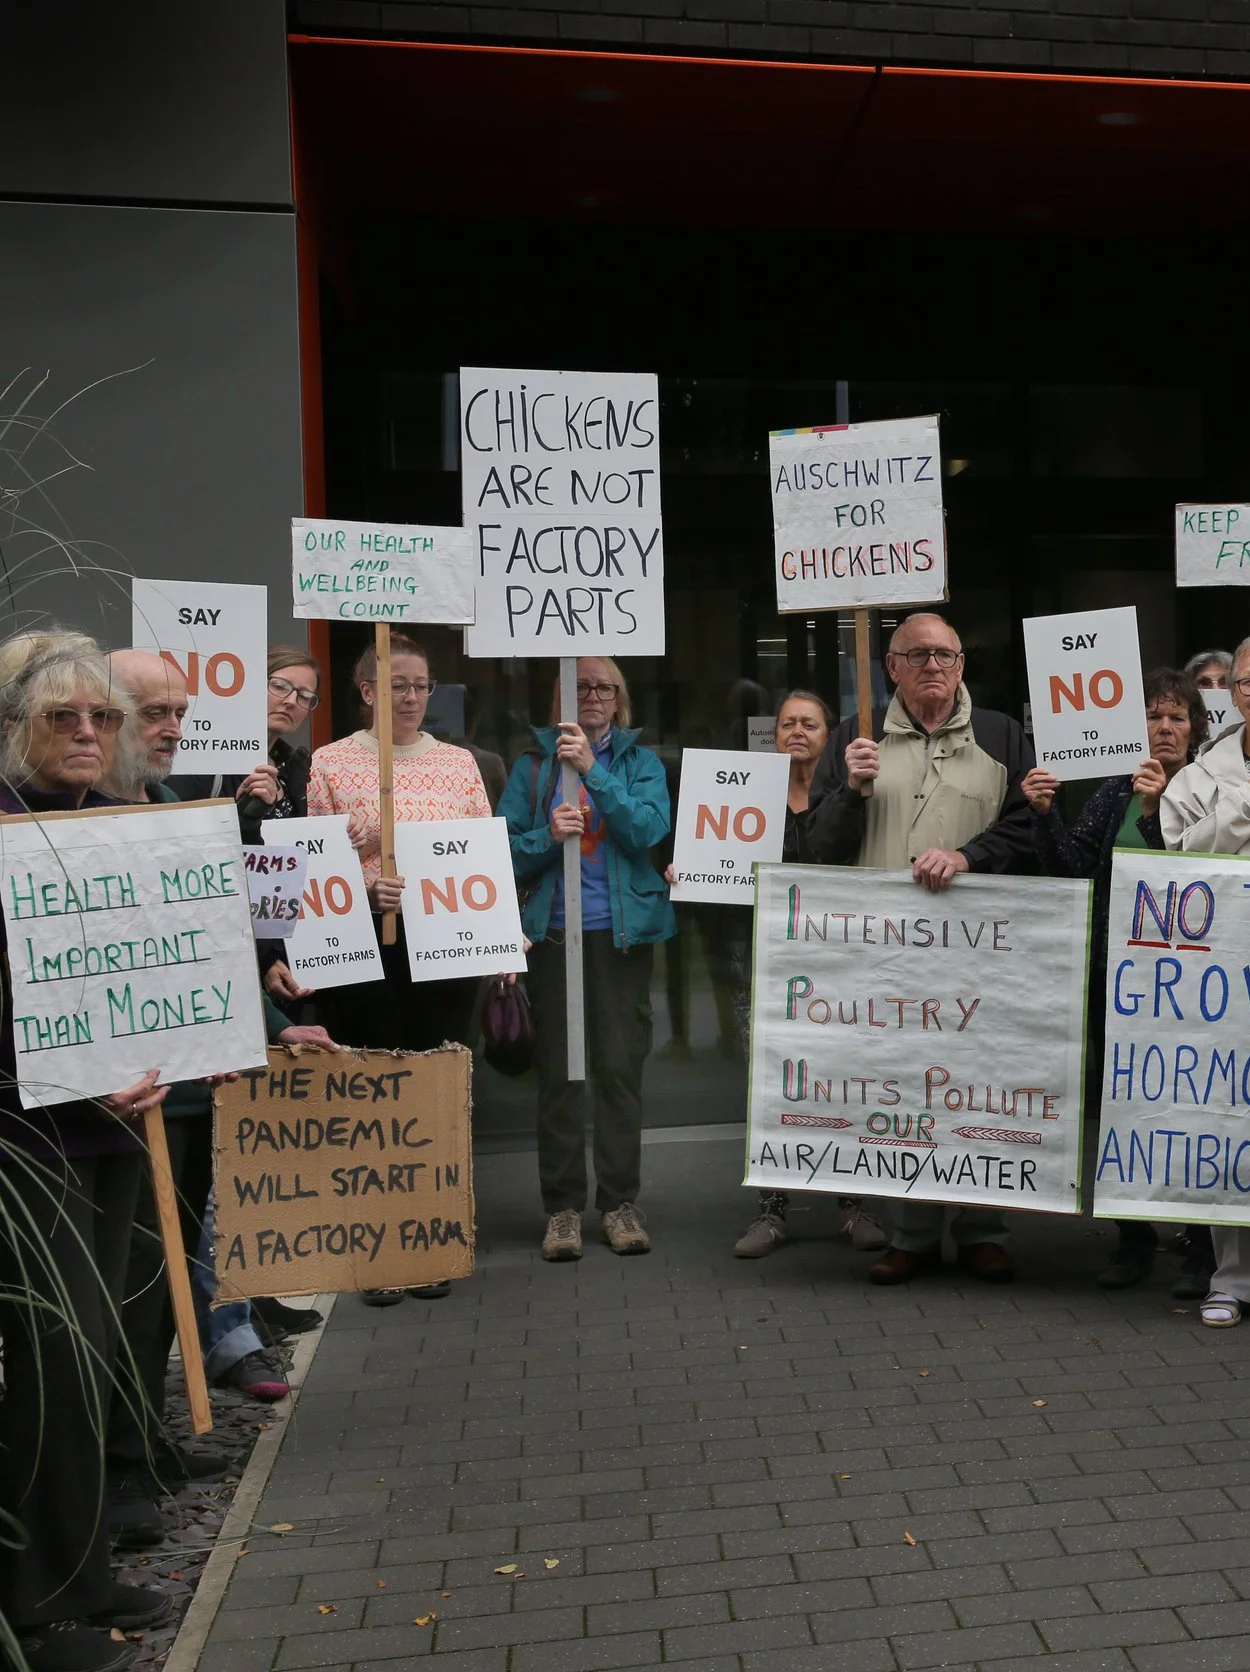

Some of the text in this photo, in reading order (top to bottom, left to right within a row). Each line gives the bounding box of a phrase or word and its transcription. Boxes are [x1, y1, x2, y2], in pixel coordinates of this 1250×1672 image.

[478, 464, 654, 508] ARE NOT
[775, 456, 934, 493] AUSCHWITZ
[834, 499, 885, 528] FOR
[1183, 509, 1240, 534] KEEP
[305, 530, 434, 553] OUR HEALTH
[479, 524, 660, 577] FACTORY
[350, 560, 390, 572] AND
[782, 539, 935, 580] CHICKENS
[299, 573, 418, 594] WELLBEING
[178, 608, 221, 625] SAY
[339, 602, 410, 617] COUNT
[506, 586, 637, 637] PARTS
[1061, 633, 1098, 651] SAY
[159, 651, 245, 697] NO
[1049, 669, 1124, 714] NO
[193, 720, 211, 731] TO
[1208, 710, 1226, 723] AY
[212, 740, 260, 750] FARMS
[1082, 730, 1099, 741] TO
[1043, 742, 1142, 762] FACTORY FARMS
[715, 771, 751, 785] SAY
[695, 804, 766, 842] NO
[432, 840, 469, 855] SAY
[243, 852, 298, 875] ARMS
[720, 860, 734, 869] TO
[10, 861, 235, 920] HEALTH MORE
[678, 873, 755, 886] FACTORY FAR
[297, 876, 353, 919] NO
[420, 874, 497, 915] NO
[787, 884, 1012, 951] INTENSIVE
[1131, 880, 1215, 941] NO
[326, 937, 339, 947] TO
[457, 932, 473, 941] TO
[26, 929, 206, 982] IMPORTANT
[295, 950, 375, 969] FACTORY FARMS
[416, 944, 518, 961] FACTORY FARMS
[14, 981, 231, 1053] THAN MONEY
[786, 975, 981, 1031] POULTRY
[239, 1068, 412, 1103] THE NEXT
[783, 1058, 1060, 1120] UNITS POLLUTE
[236, 1117, 433, 1155] PANDEMIC
[866, 1112, 935, 1141] OUR
[760, 1141, 1037, 1193] AIR/LAND/WATER
[233, 1163, 459, 1207] WILL START IN
[224, 1218, 467, 1270] A FACTORY FARM
